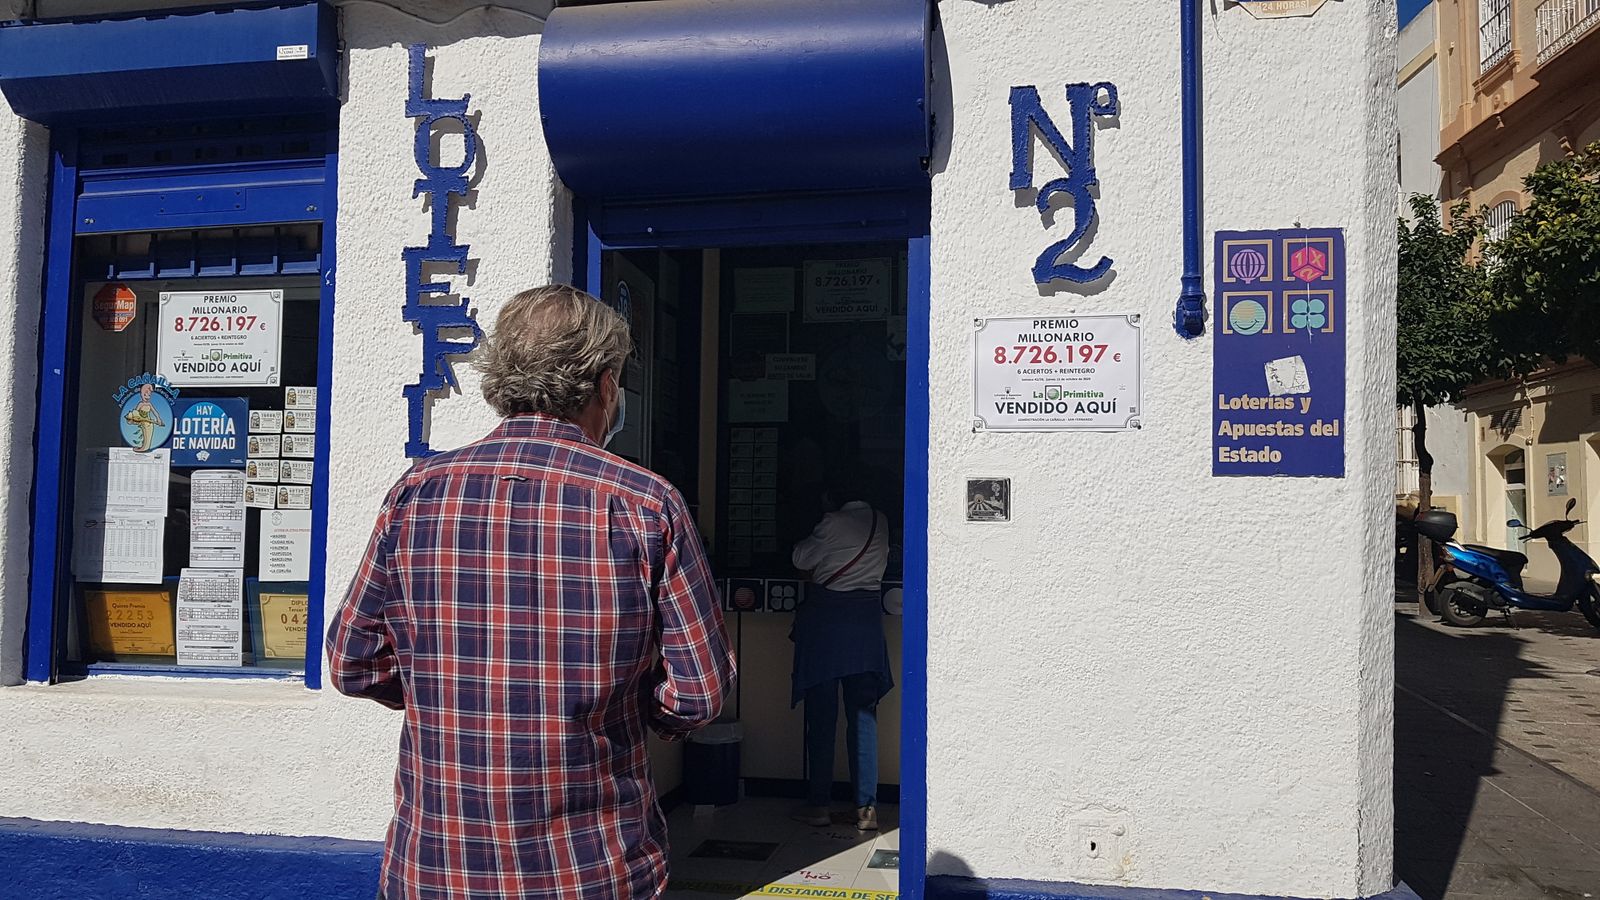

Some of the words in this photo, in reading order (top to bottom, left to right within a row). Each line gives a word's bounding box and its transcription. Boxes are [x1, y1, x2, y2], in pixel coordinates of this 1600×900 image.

[1262, 3, 1273, 11] 24
[1276, 1, 1305, 10] HORAS
[1031, 177, 1114, 283] 2
[402, 42, 483, 459] LOTERI
[815, 275, 873, 287] 8.726.197
[204, 295, 237, 303] PREMIO
[192, 306, 248, 314] MILLONARIO
[815, 305, 853, 314] VENDIDO
[175, 316, 257, 332] 8.726.197
[260, 322, 266, 330] €
[1033, 319, 1079, 330] PREMIO
[1018, 332, 1095, 343] MILLONARIO
[994, 344, 1109, 365] 8.726.197
[1113, 353, 1122, 363] €
[174, 362, 226, 373] VENDIDO
[231, 359, 261, 373] AQUÍ
[112, 386, 129, 402] LA
[128, 371, 180, 400] CAÑAILLA
[1033, 391, 1043, 399] La
[1063, 390, 1104, 399] Primitiva
[196, 406, 214, 415] HAY
[995, 401, 1068, 414] VENDIDO
[1074, 398, 1117, 414] AQUÍ
[1300, 396, 1312, 414] y
[173, 412, 236, 435] LOTERÍA
[1218, 420, 1304, 440] Apuestas
[1310, 419, 1339, 437] del
[172, 437, 186, 449] DE
[189, 437, 236, 449] NAVIDAD
[1219, 446, 1282, 463] Estado
[106, 610, 154, 620] 22253
[768, 886, 847, 898] DISTANCIA
[851, 892, 872, 900] DE
